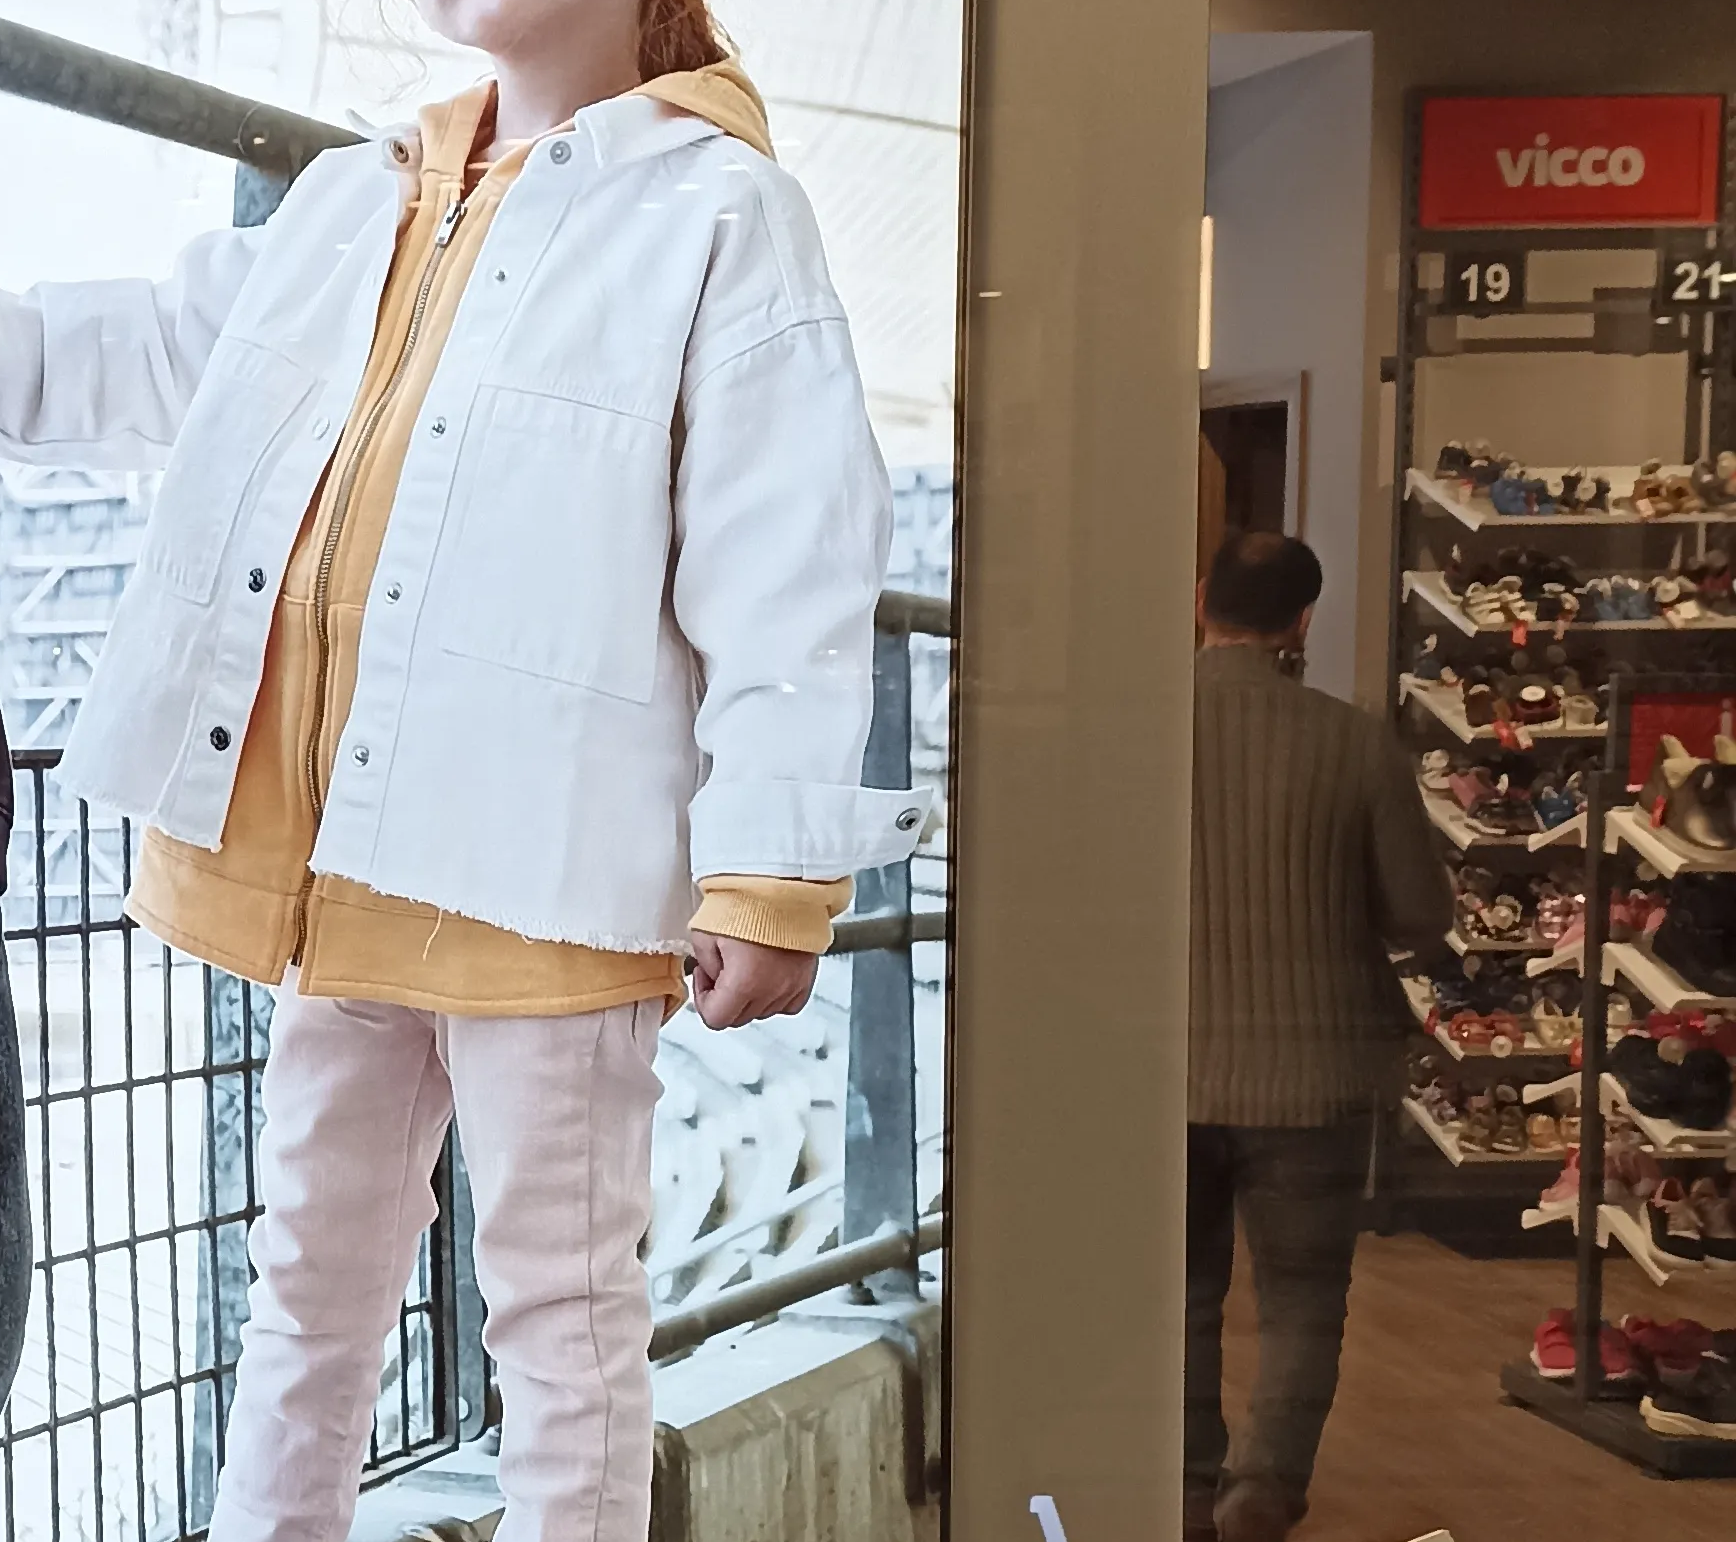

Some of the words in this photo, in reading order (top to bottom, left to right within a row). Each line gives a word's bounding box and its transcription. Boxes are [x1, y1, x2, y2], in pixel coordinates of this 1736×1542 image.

[1496, 132, 1645, 187] vicco
[1460, 263, 1511, 302] 19
[1672, 262, 1722, 301] 21
